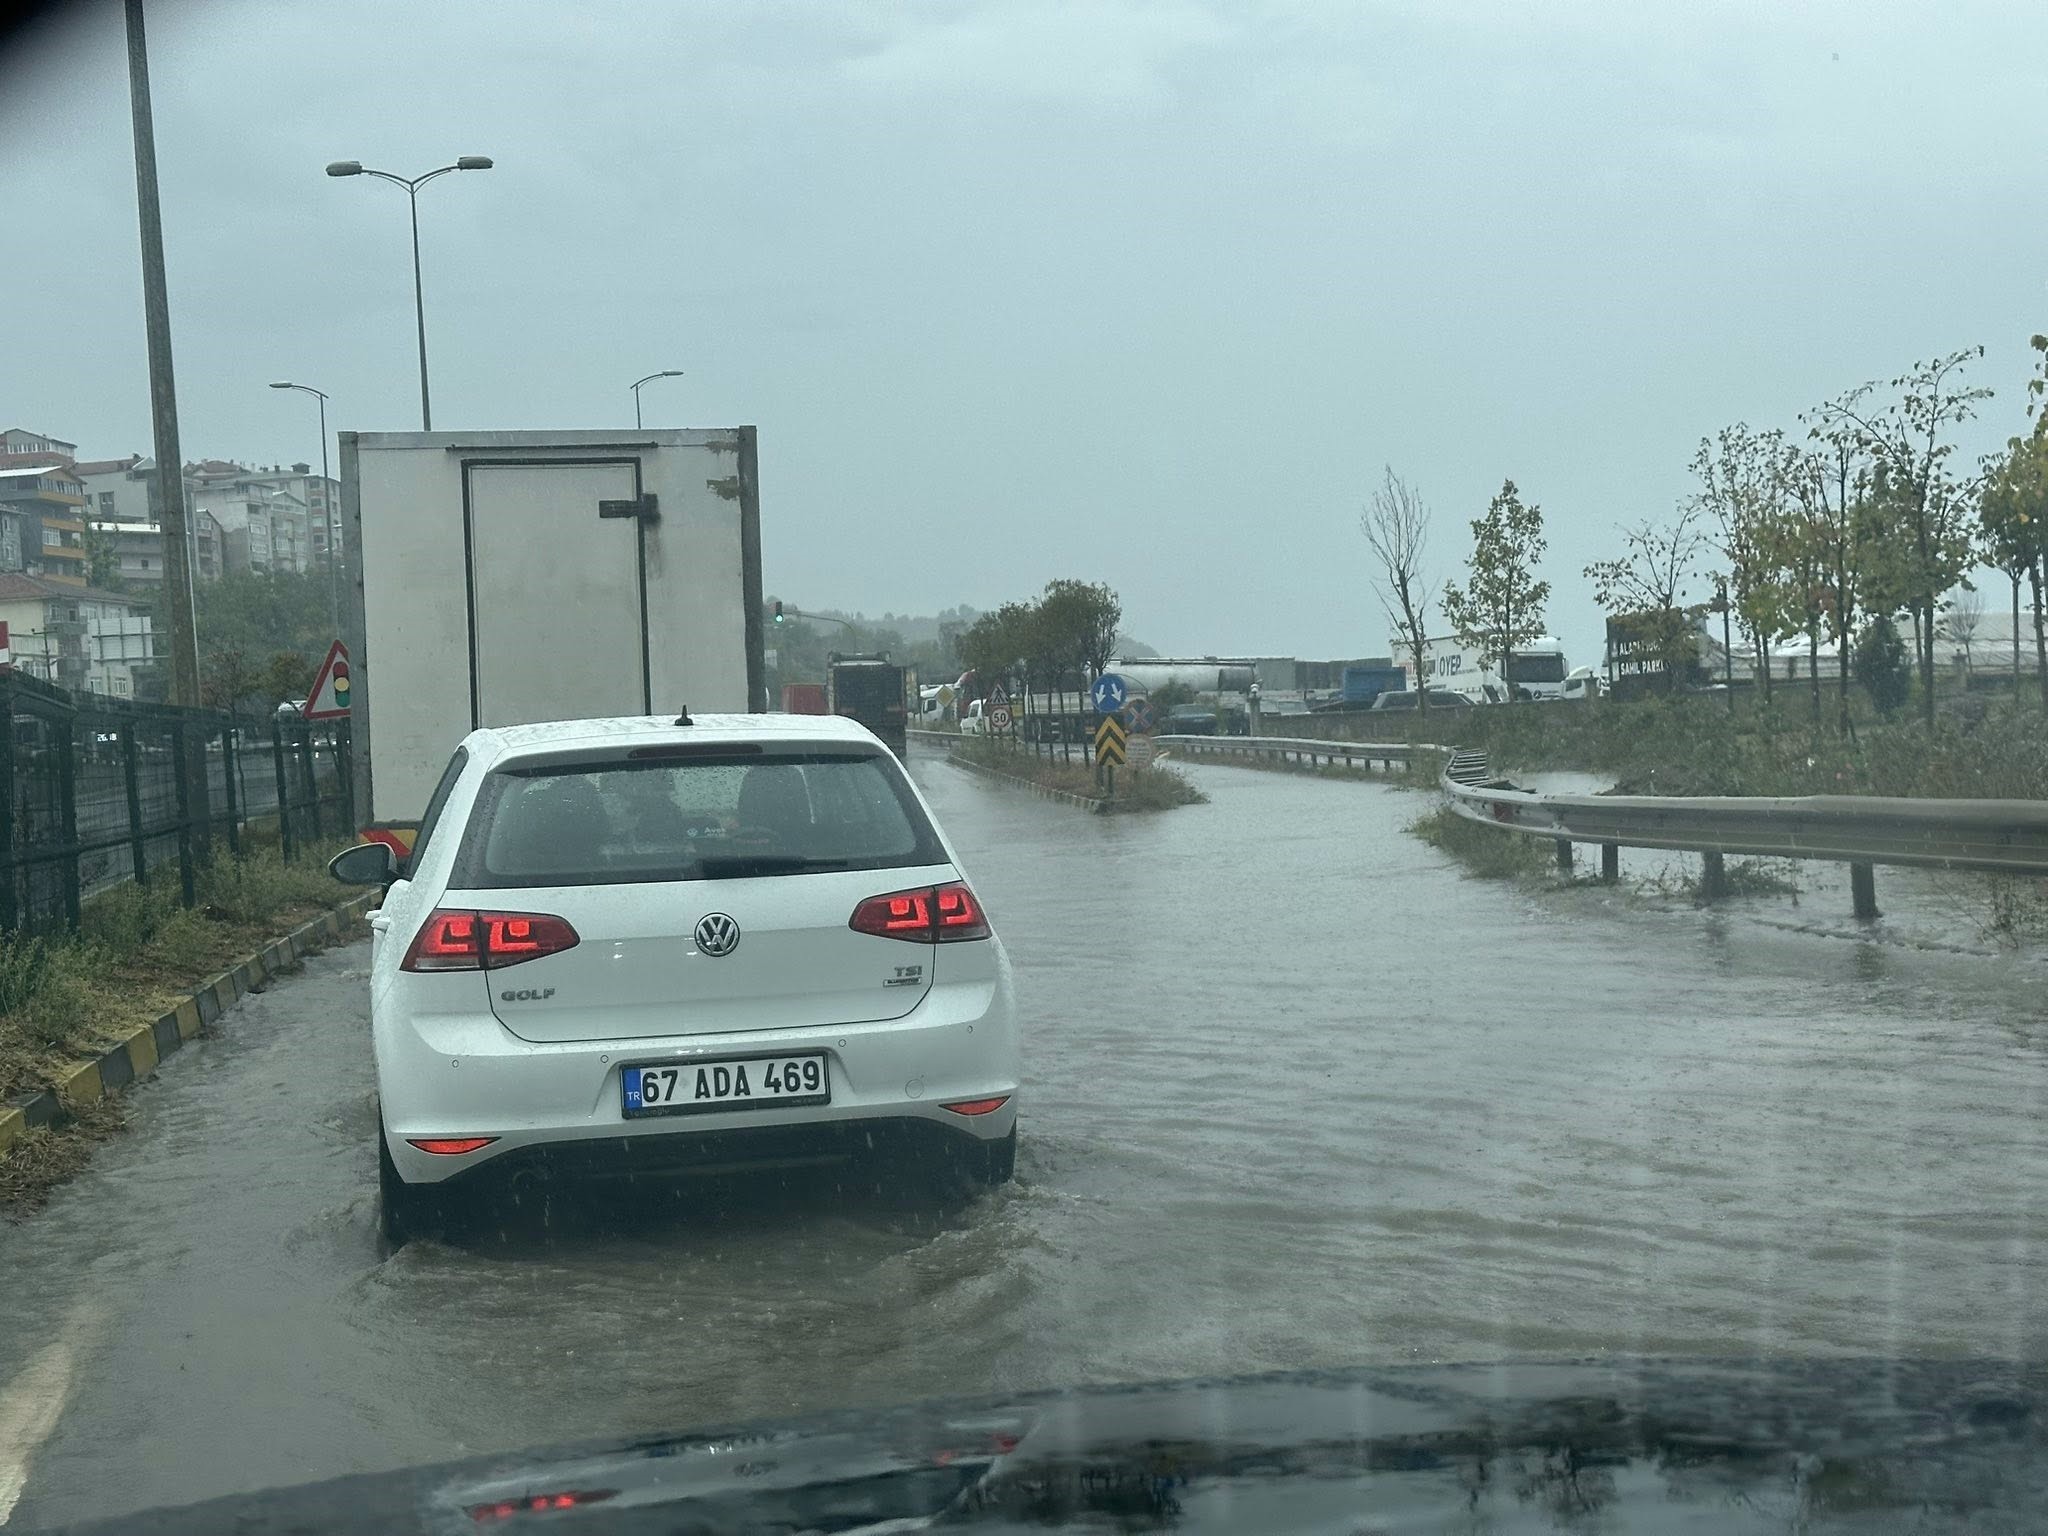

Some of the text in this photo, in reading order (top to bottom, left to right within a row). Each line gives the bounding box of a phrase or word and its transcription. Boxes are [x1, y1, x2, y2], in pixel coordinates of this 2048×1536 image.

[993, 712, 1006, 723] 50
[894, 965, 923, 977] TSI
[501, 987, 556, 1002] GOLF
[626, 1060, 820, 1104] TR 67 ADA 469
